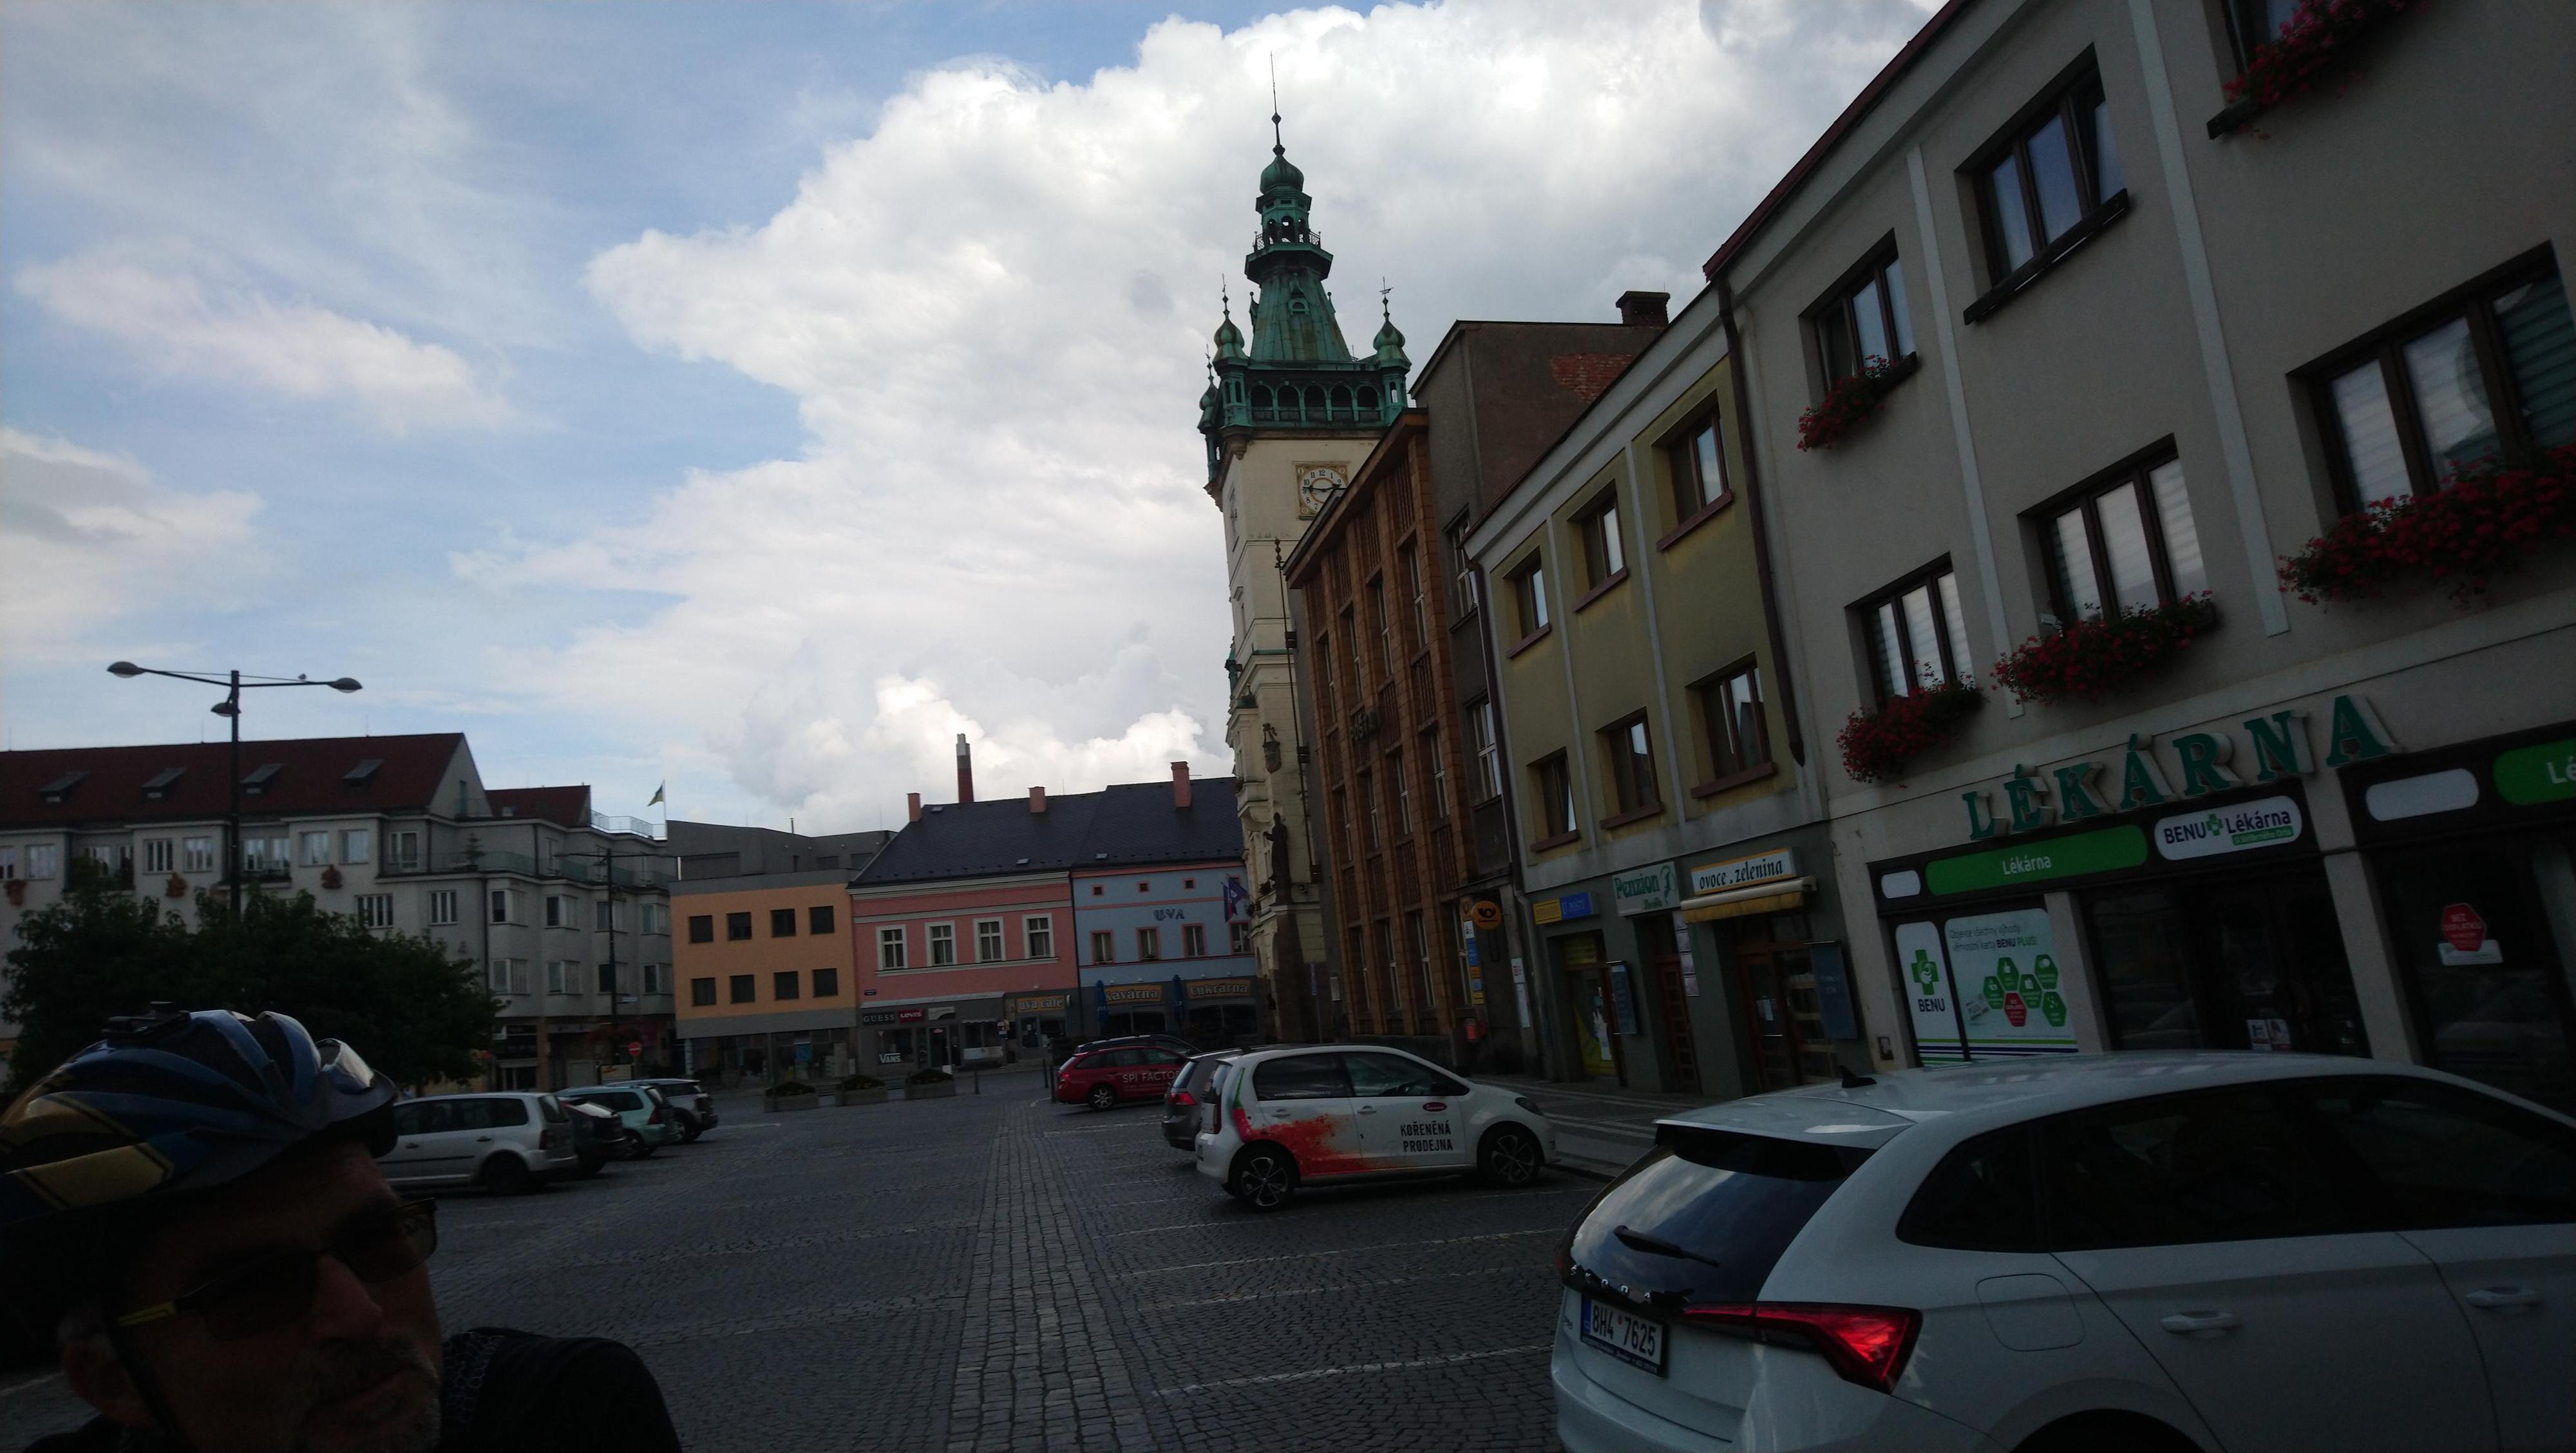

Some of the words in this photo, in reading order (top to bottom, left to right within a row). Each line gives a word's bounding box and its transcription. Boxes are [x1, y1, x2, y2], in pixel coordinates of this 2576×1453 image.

[1962, 695, 2391, 840] LÉKÁRNA
[2164, 822, 2206, 844] BENU
[2225, 811, 2291, 833] Lékárna
[2002, 855, 2052, 875] Lékárna
[1700, 872, 1725, 889] ovoce
[1735, 859, 1783, 882] zelenina
[1614, 873, 1660, 899] Penzion
[1153, 909, 1184, 920] UVA
[1996, 938, 2016, 948] BENU
[1190, 984, 1248, 996] Cukrárna
[1918, 999, 1945, 1012] BENU
[863, 1014, 895, 1022] GUESS
[1122, 1074, 1138, 1083] SPI
[1401, 1120, 1451, 1136] KOŘENĚNÁ
[1403, 1139, 1453, 1152] PRODEJNA
[1593, 1305, 1614, 1340] 8H4
[1624, 1316, 1656, 1356] 7625
